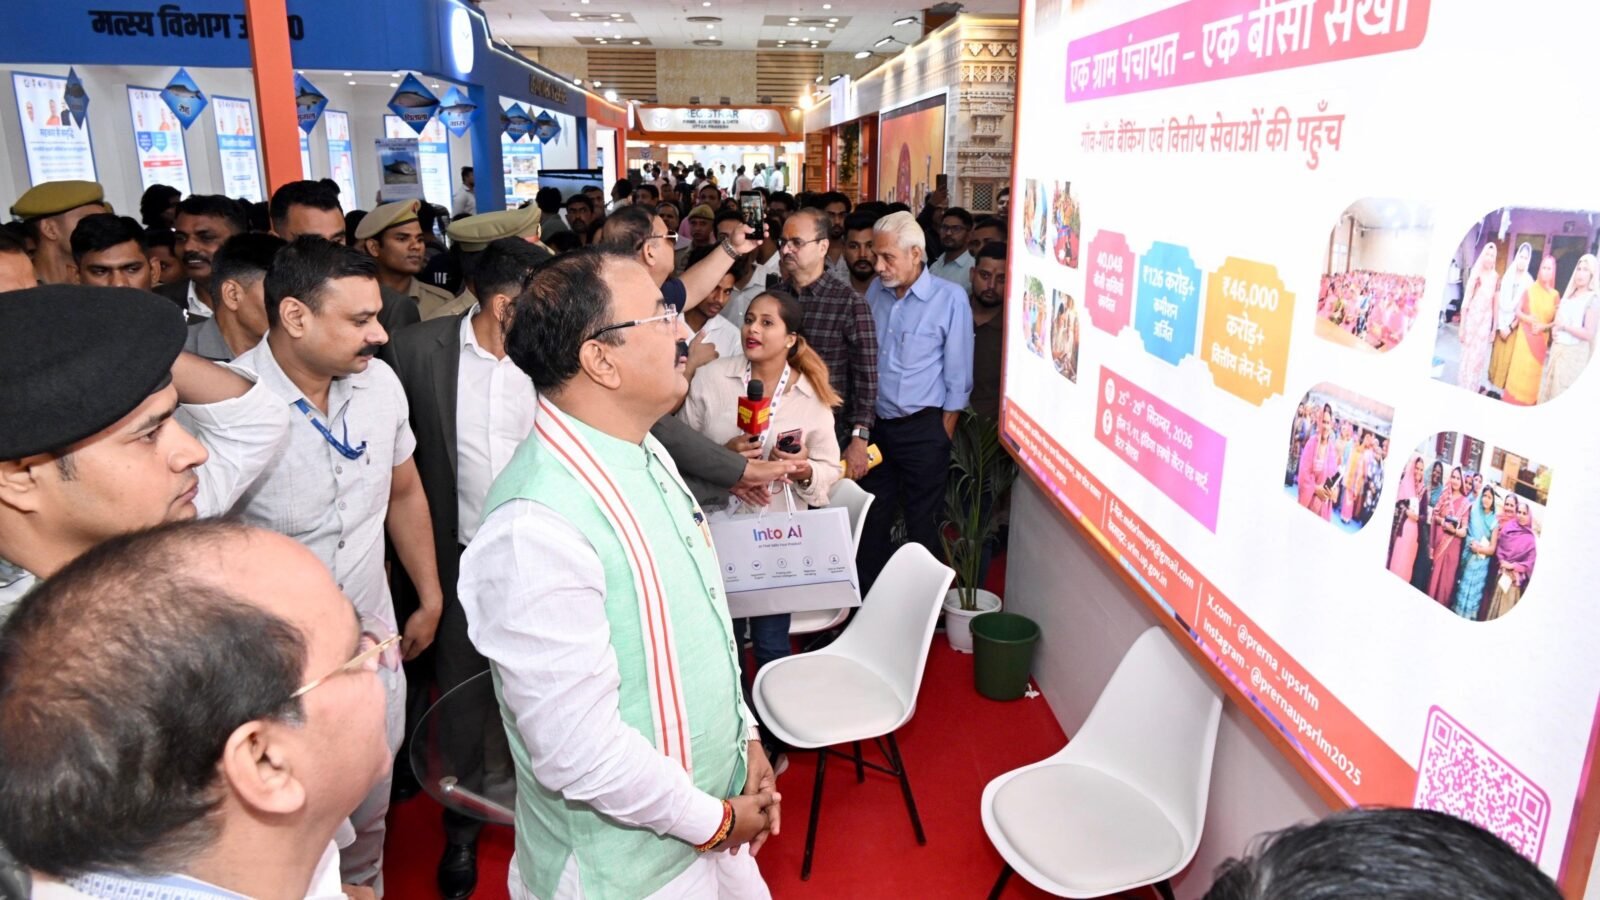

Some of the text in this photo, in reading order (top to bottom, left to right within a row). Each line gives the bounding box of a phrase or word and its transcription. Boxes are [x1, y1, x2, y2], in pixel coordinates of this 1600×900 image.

[88, 10, 155, 37] मत्स्य
[157, 4, 231, 39] विभाग
[1071, 57, 1091, 92] एक
[1093, 49, 1118, 89] ग्राम
[1121, 32, 1180, 83] पंचायत
[1202, 14, 1243, 67] एक
[1149, 118, 1165, 152] एवं
[1168, 115, 1207, 152] वित्तीय
[1211, 108, 1264, 152] सेवाओं
[1266, 106, 1292, 152] की
[1298, 99, 1345, 170] पहुँच
[1222, 276, 1279, 312] ₹46,000
[1238, 354, 1272, 387] लेन-देन
[753, 527, 783, 543] Into
[1206, 593, 1232, 627] X.com
[1237, 624, 1320, 711] @prerna_upsrlm
[1203, 618, 1245, 669] Instagram
[1251, 666, 1362, 786] @prernaupsrlm2025
